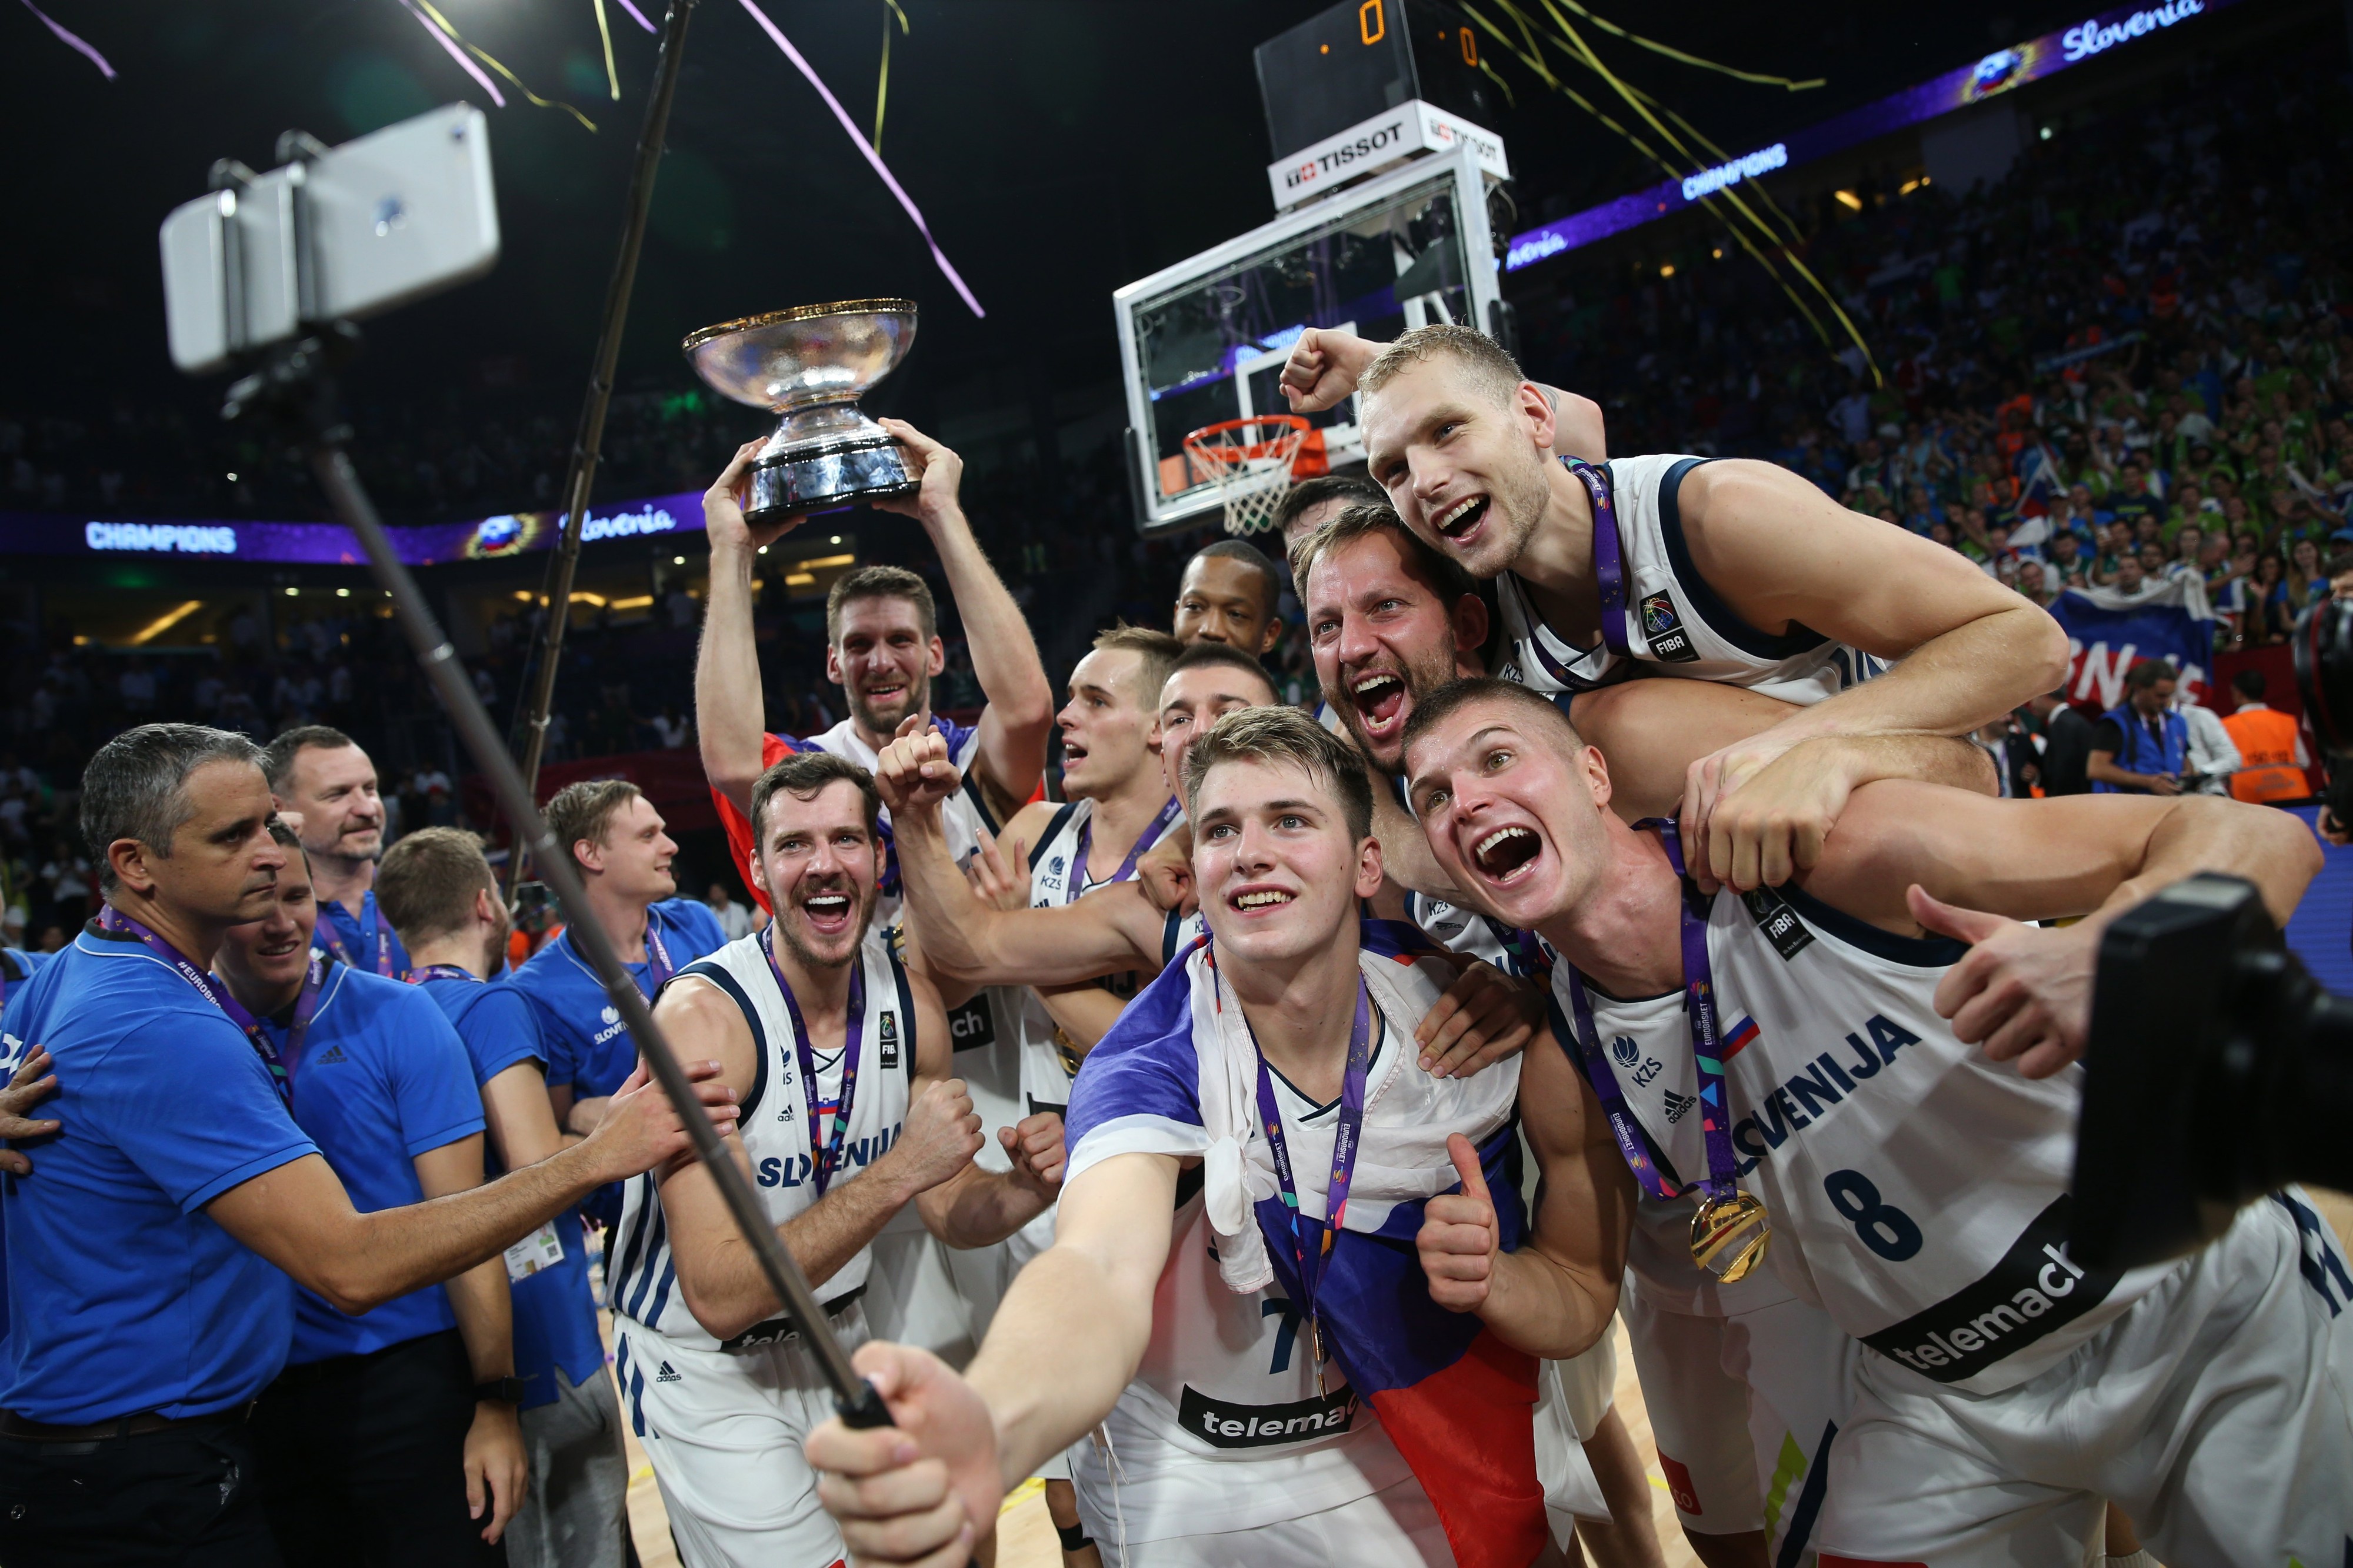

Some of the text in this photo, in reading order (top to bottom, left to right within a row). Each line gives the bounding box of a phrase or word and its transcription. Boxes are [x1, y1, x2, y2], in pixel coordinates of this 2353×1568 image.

[1317, 121, 1404, 172] TISSOT
[85, 522, 236, 554] CHAMPIONS
[1656, 636, 1685, 654] FIBA
[1769, 913, 1795, 939] FIBA
[1700, 1003, 1712, 1045] EUROBASKET
[882, 1045, 896, 1055] FIB
[1631, 1057, 1662, 1087] KZS
[1668, 1096, 1697, 1124] adidas
[1338, 1123, 1350, 1163] EUROBASKET
[1612, 1112, 1634, 1150] EUROBASKET
[1275, 1142, 1288, 1181] EUROBASKET
[1824, 1169, 1923, 1262] 8
[1262, 1298, 1302, 1374] 7
[656, 1373, 682, 1382] adidas
